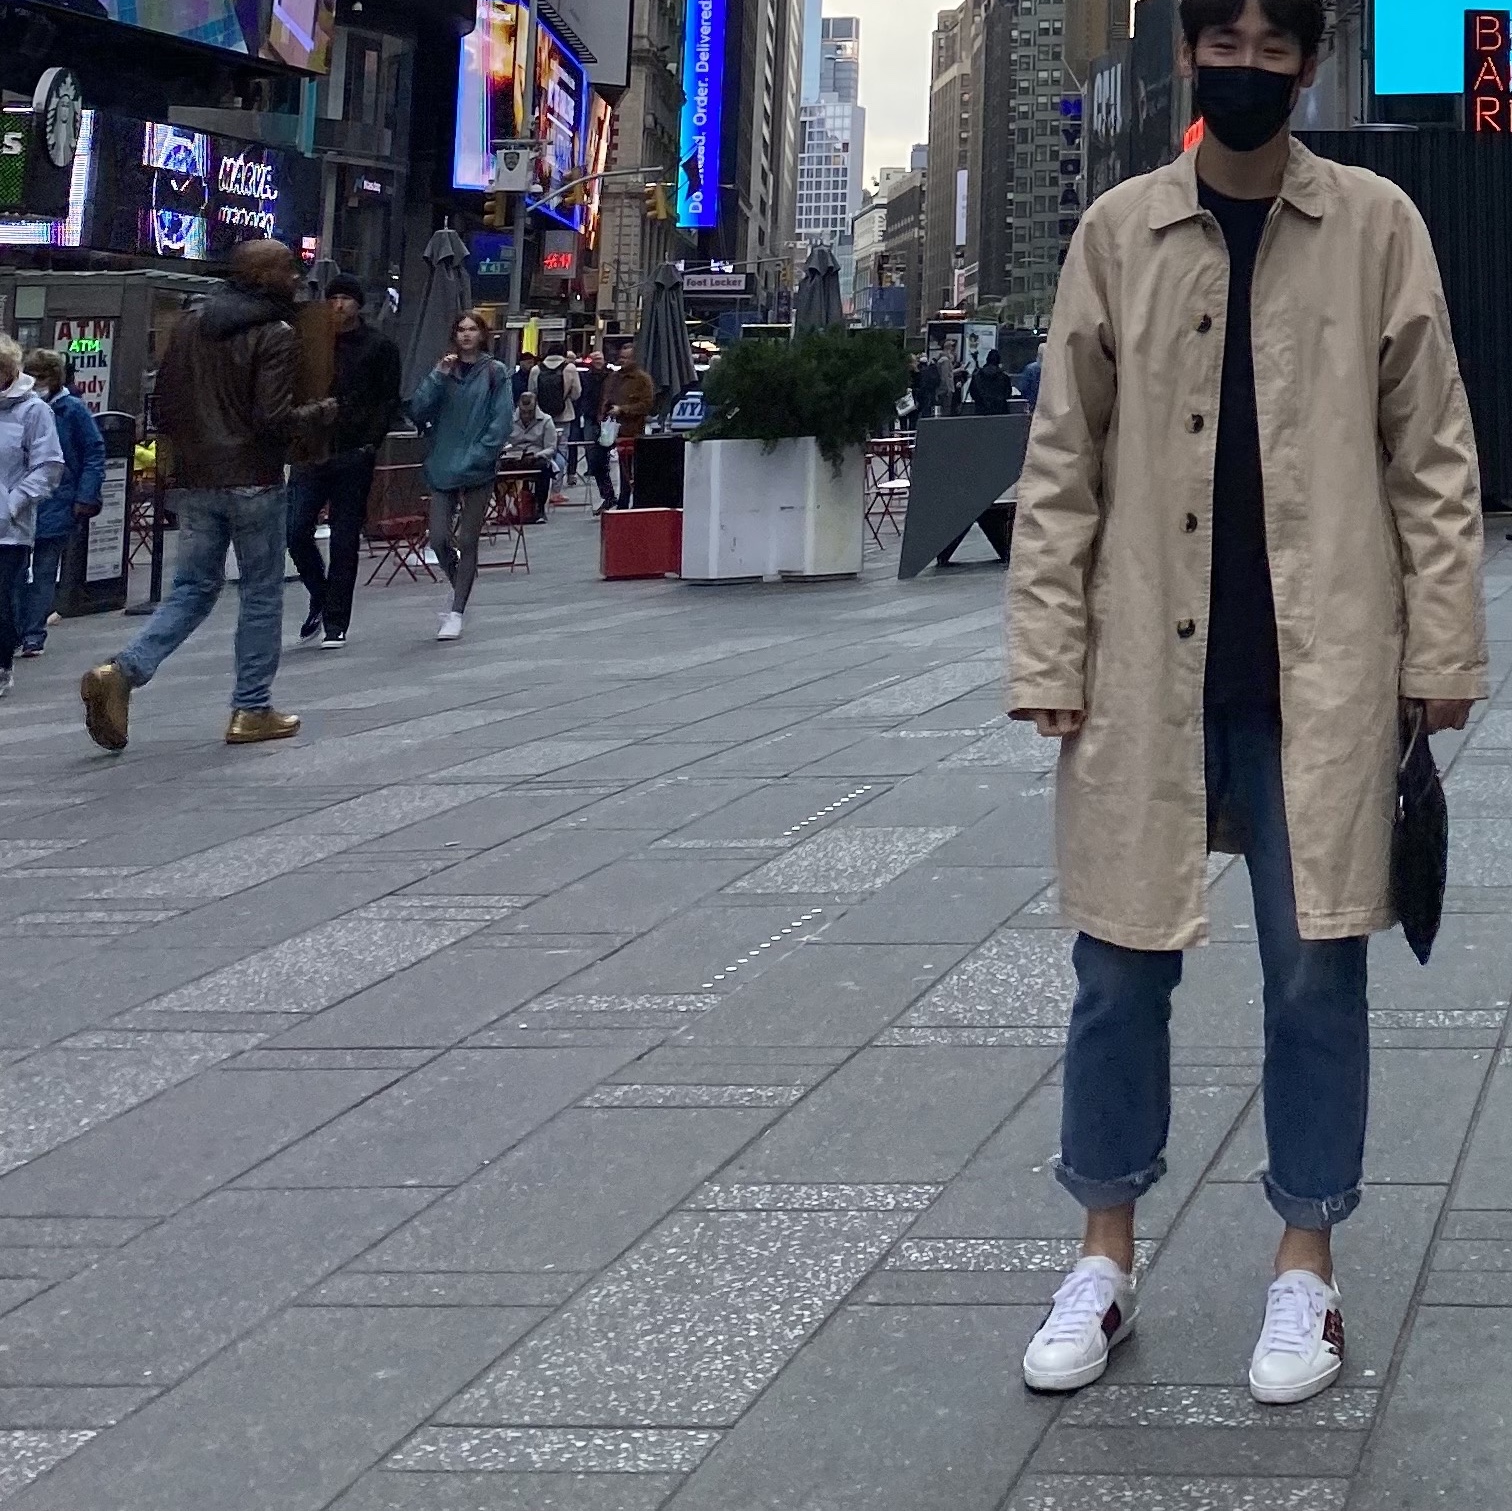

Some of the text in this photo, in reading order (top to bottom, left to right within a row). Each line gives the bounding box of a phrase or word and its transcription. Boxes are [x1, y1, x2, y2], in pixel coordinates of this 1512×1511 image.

[1473, 15, 1504, 132] BAR
[693, 78, 709, 126] Order.
[710, 277, 743, 288] Locker
[57, 320, 110, 340] ATM
[69, 338, 101, 352] ATM
